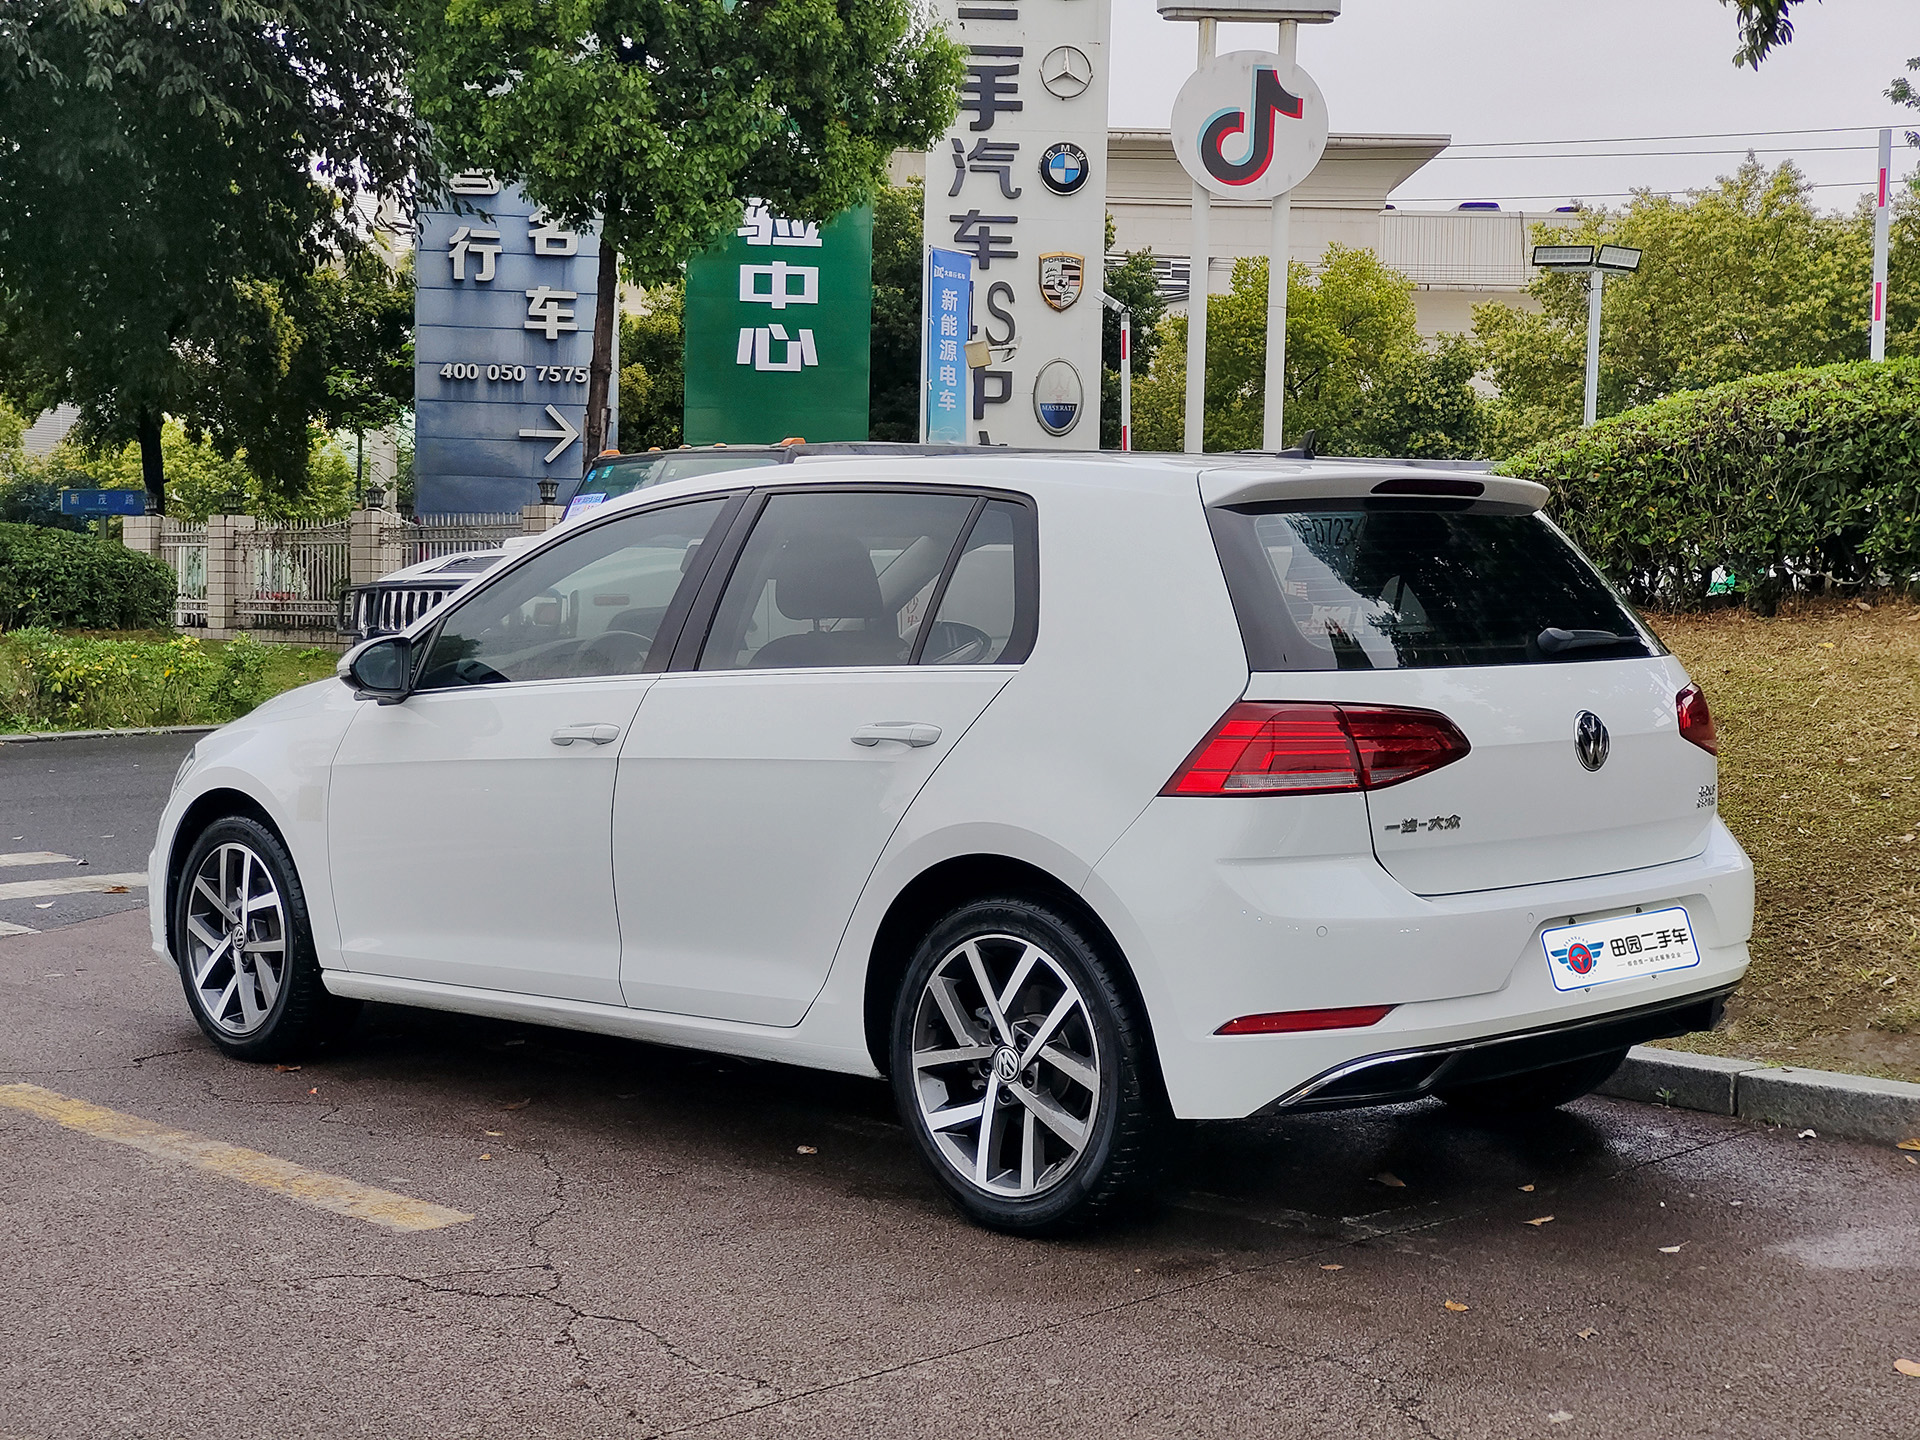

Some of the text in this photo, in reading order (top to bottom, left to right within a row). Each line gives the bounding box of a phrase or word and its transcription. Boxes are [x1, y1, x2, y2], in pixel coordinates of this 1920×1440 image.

[1045, 144, 1086, 160] BMW
[1042, 257, 1082, 266] PORSCHE
[938, 288, 959, 412] 新能源电车
[439, 362, 589, 384] 400 050 7575
[1041, 404, 1076, 412] MASERATI
[1609, 927, 1689, 957] 田园二手车
